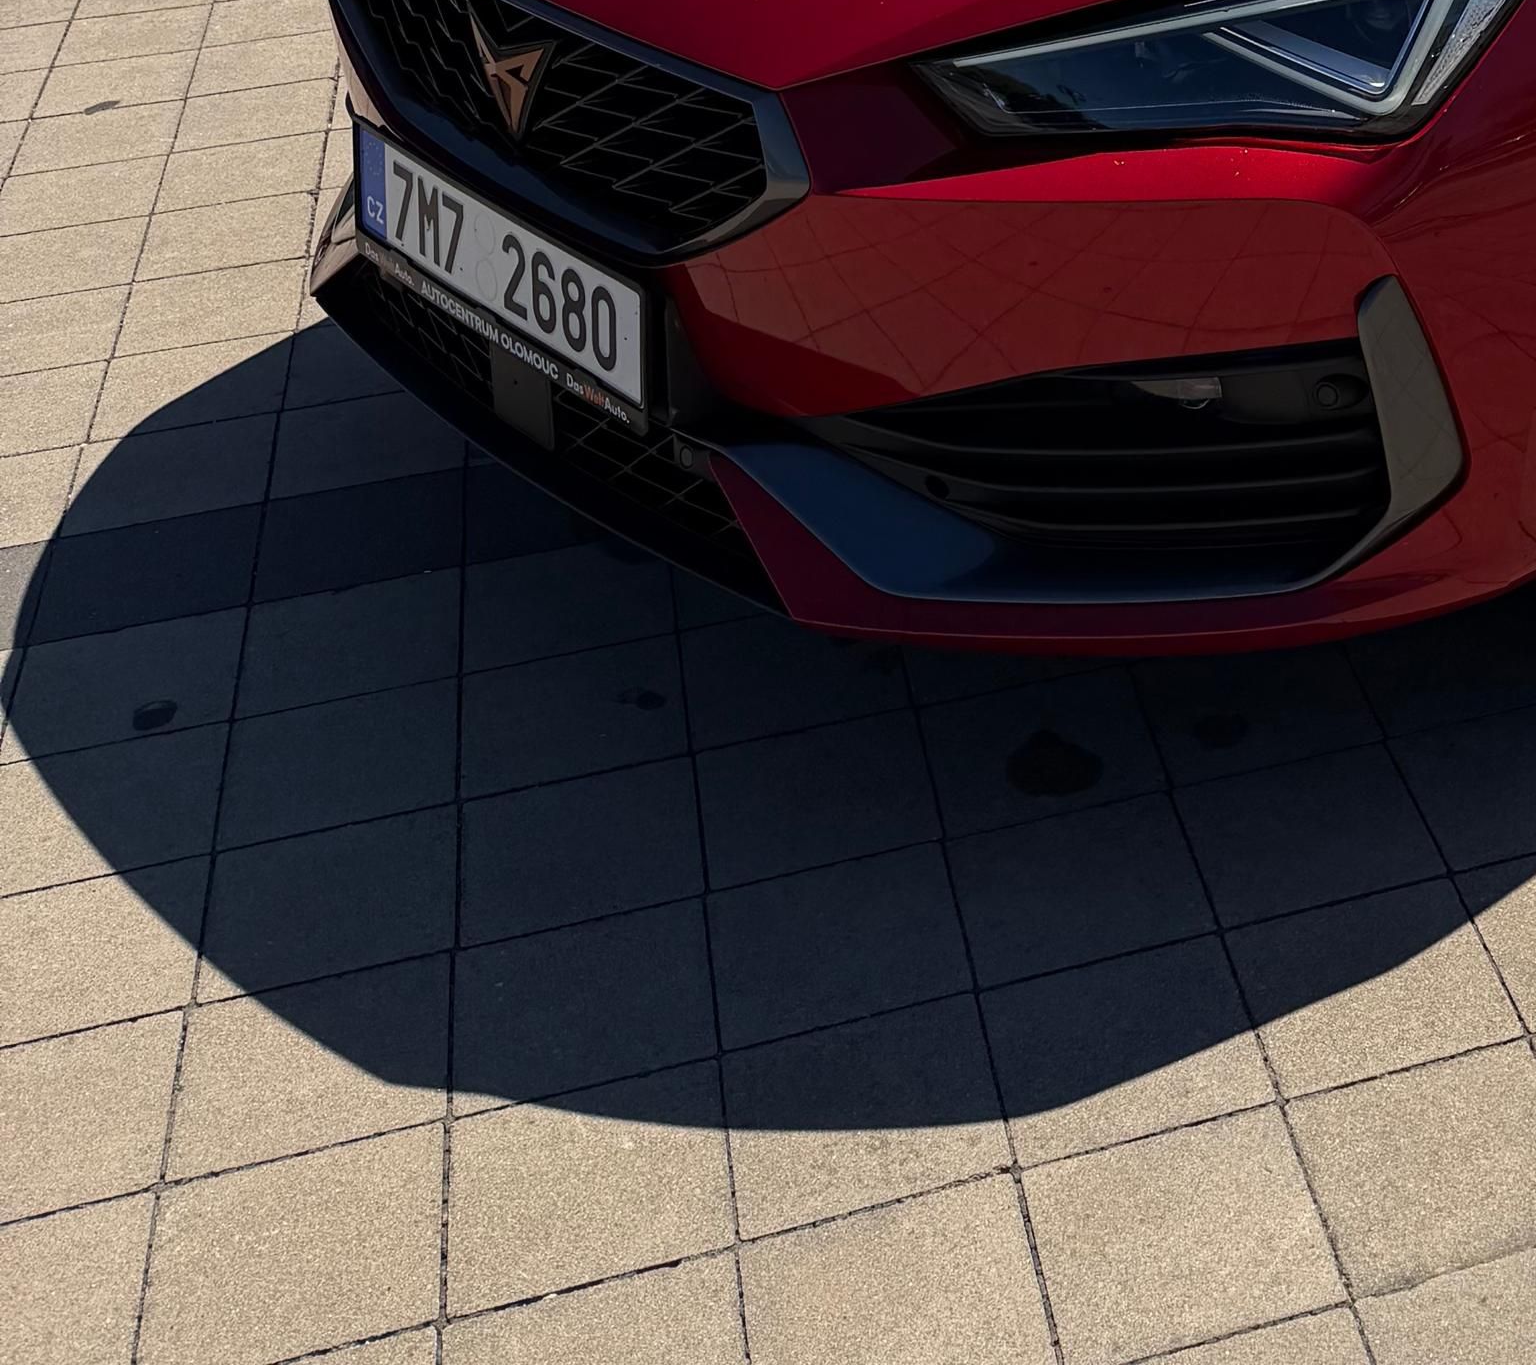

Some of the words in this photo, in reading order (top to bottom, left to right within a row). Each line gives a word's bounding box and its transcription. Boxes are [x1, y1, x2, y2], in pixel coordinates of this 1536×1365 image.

[366, 196, 384, 225] CZ
[393, 161, 464, 275] 7M7
[502, 234, 617, 371] 2680
[421, 280, 499, 344] AUTOCENTRUM
[501, 333, 559, 380] OLOMOUC
